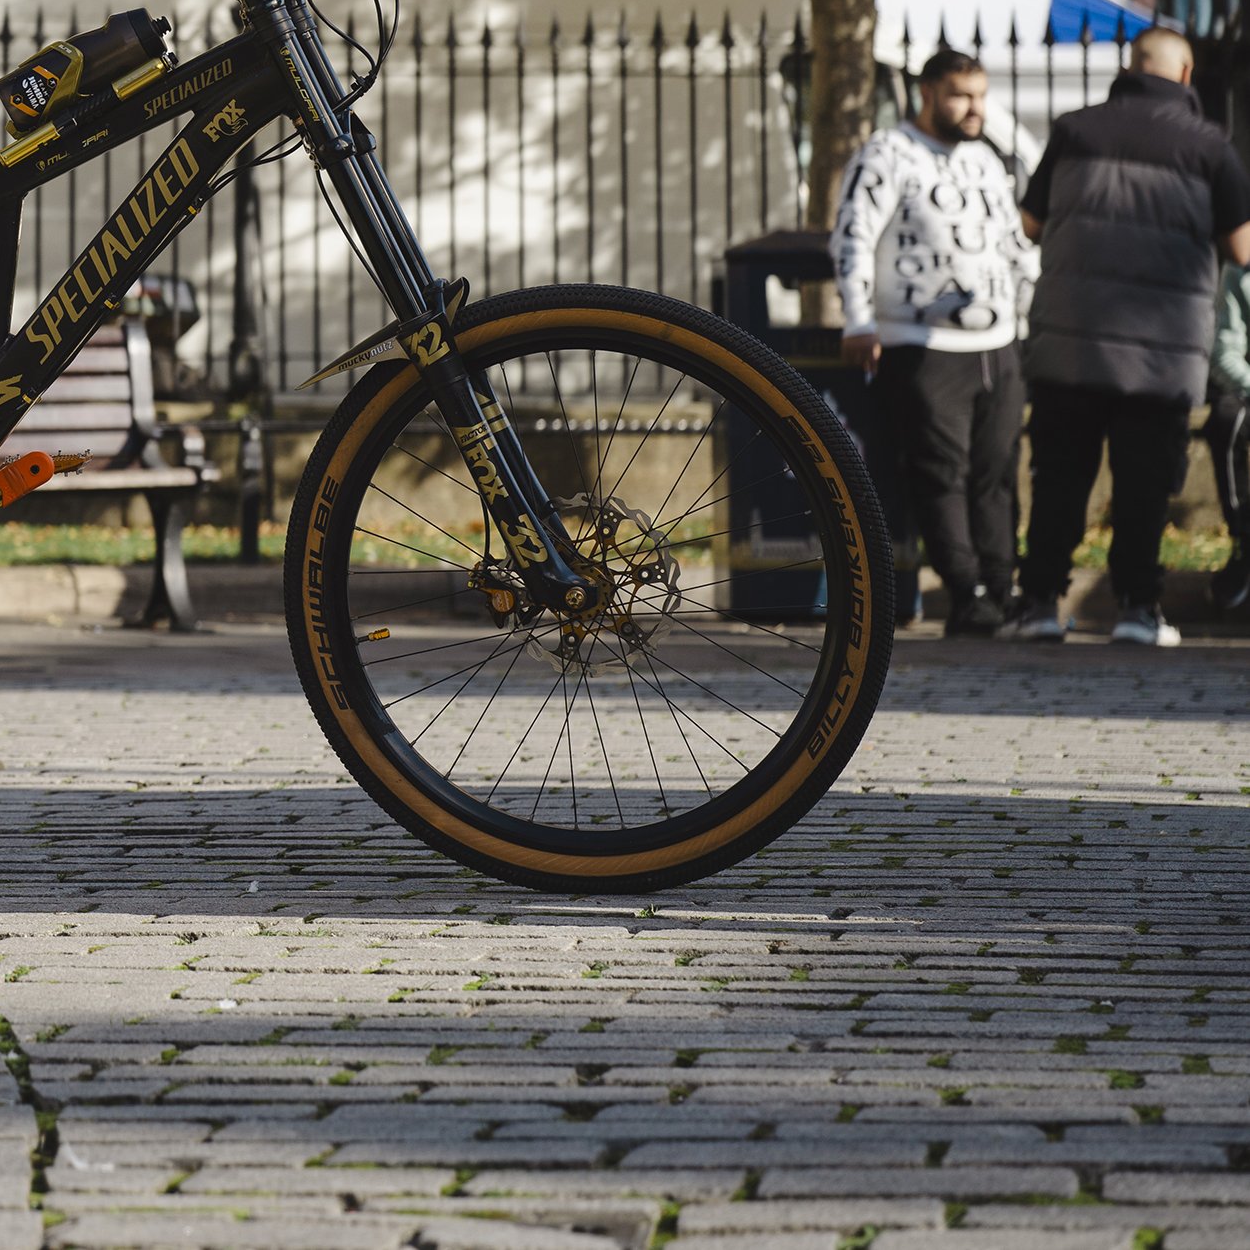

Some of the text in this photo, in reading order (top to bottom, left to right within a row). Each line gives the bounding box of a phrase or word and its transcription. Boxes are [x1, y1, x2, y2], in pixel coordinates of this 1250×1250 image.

[27, 76, 46, 106] JUMBO
[143, 58, 233, 120] SPECIALIZED
[202, 98, 248, 143] FOX
[25, 136, 200, 366] SPECIALIZED
[459, 424, 489, 444] FACTOR
[466, 440, 510, 505] FOX
[500, 513, 549, 569] 32
[308, 475, 351, 711] SCHWALBE
[807, 657, 856, 761] BILLY
